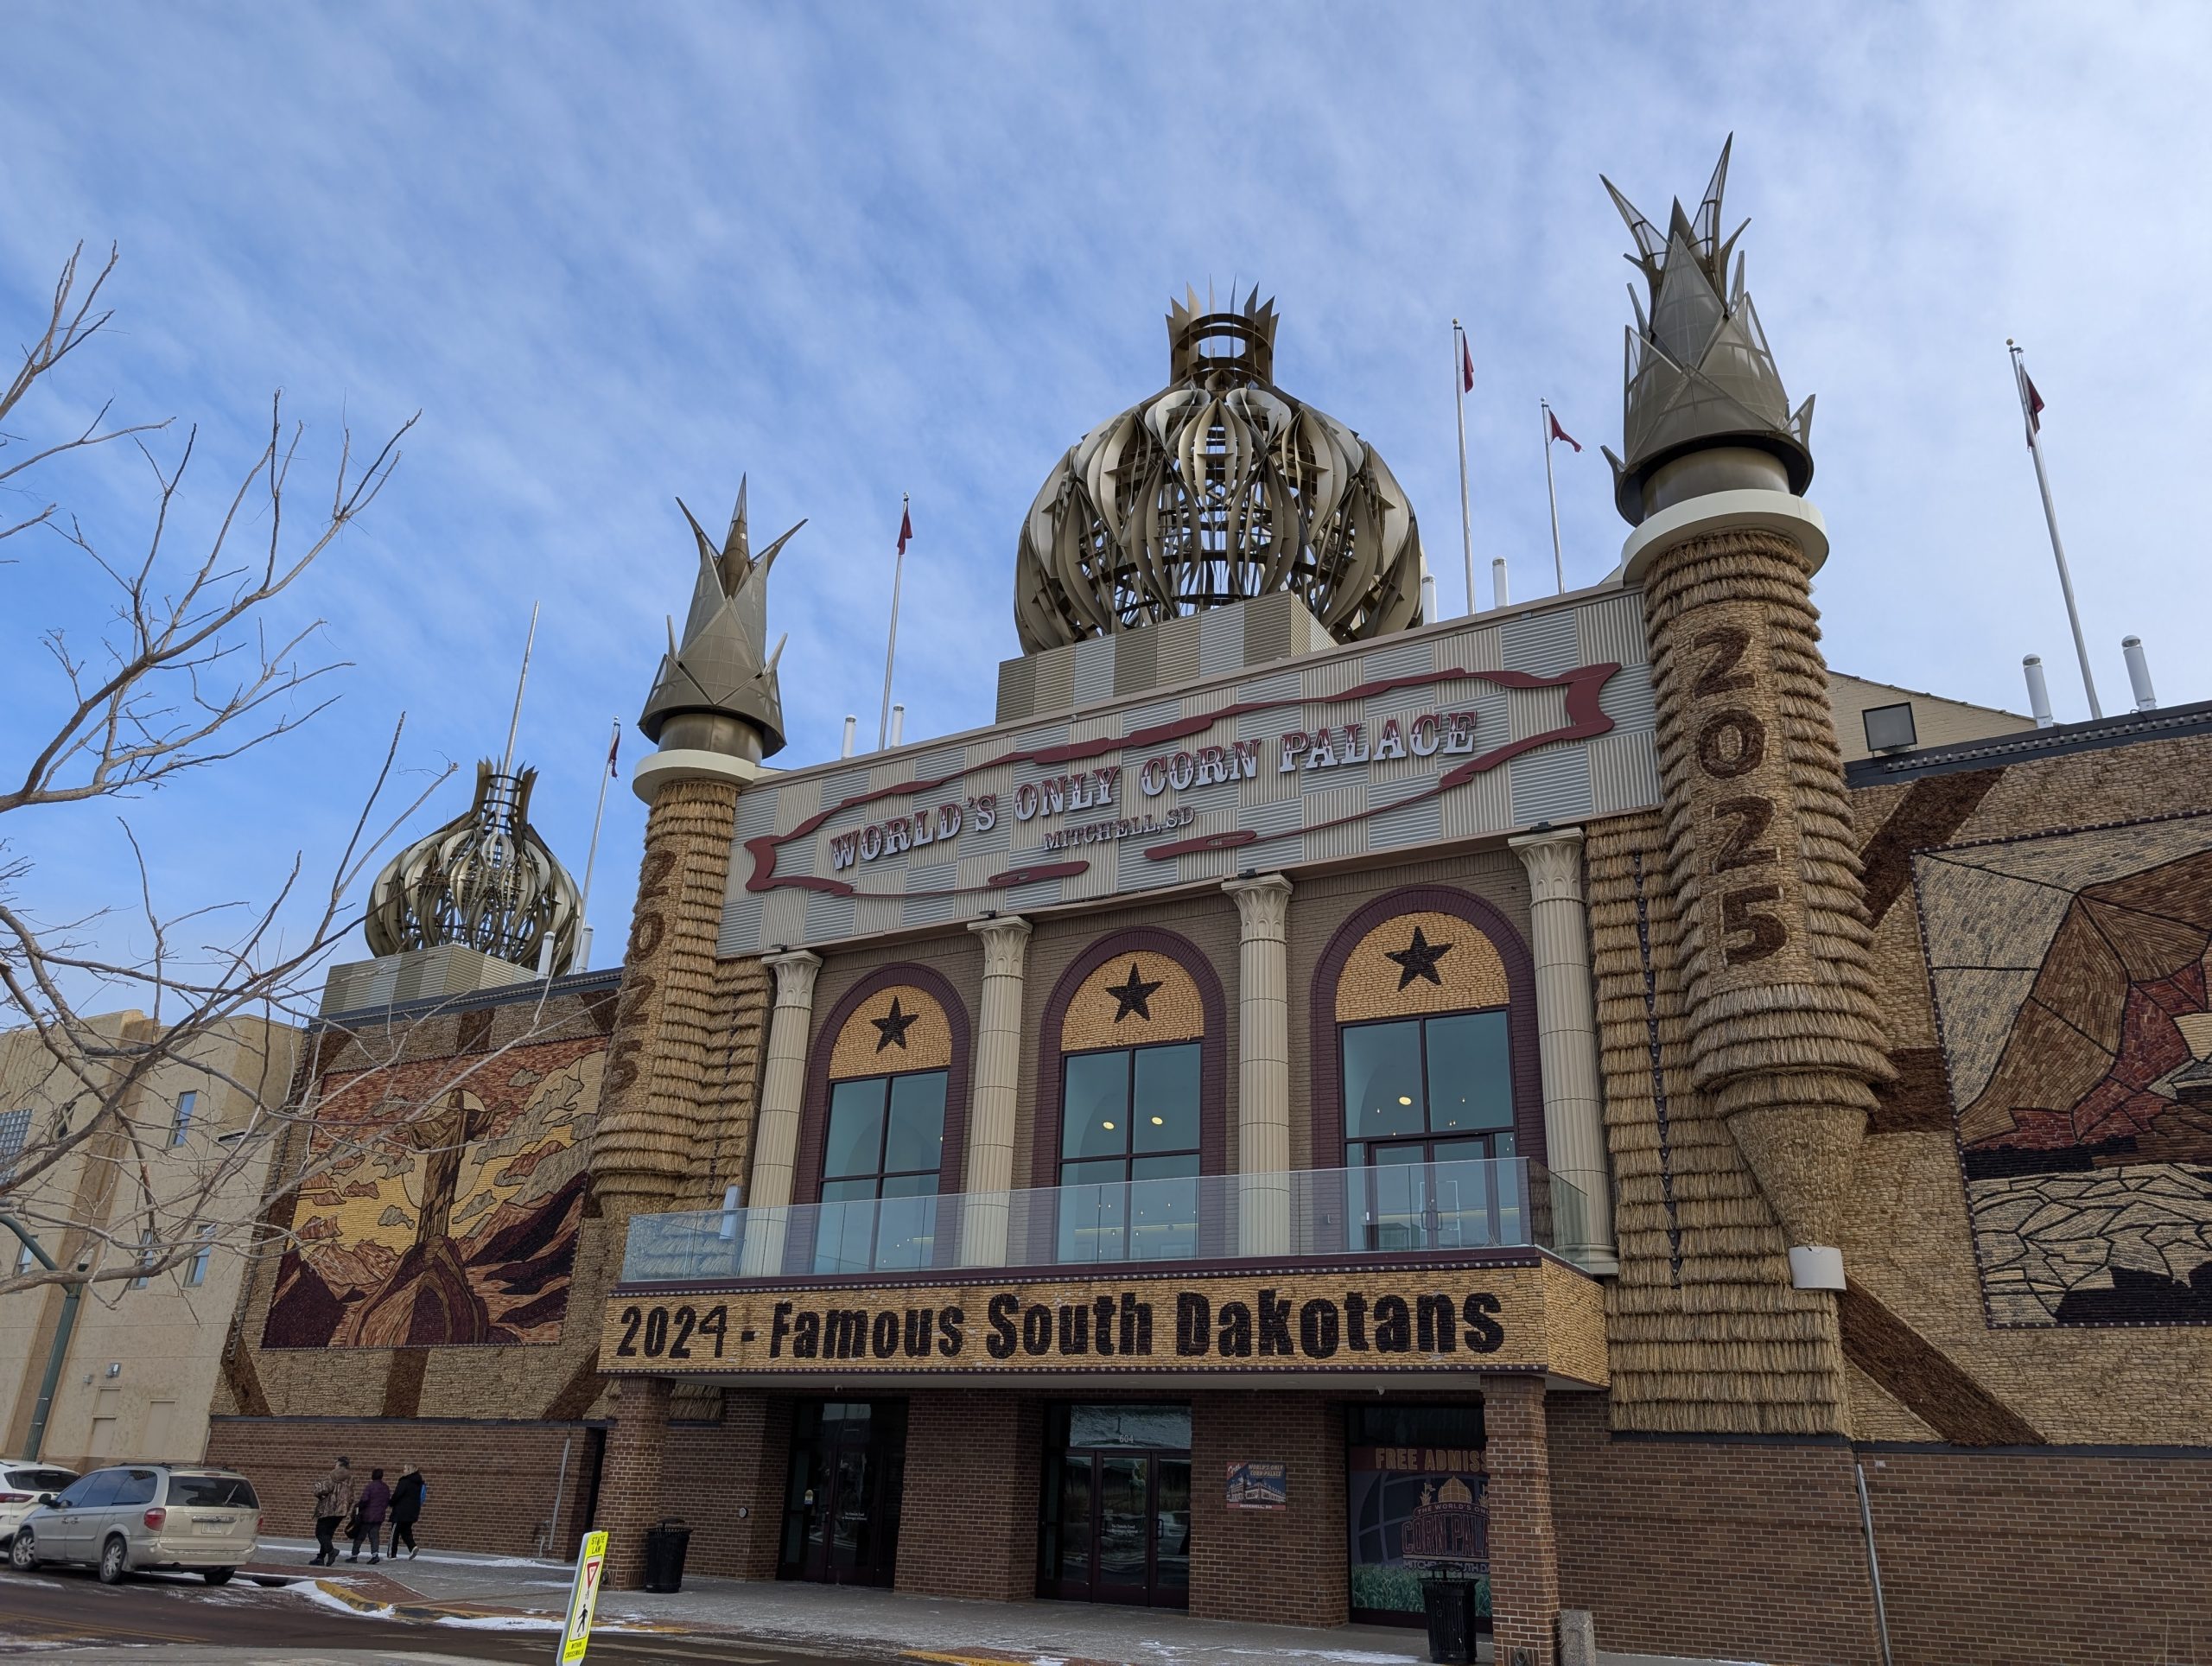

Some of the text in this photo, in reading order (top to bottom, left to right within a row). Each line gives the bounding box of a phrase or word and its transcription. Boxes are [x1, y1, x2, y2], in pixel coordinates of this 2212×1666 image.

[830, 710, 1478, 870] WORLD'S ONLY CORN PALACE
[1691, 625, 1789, 966] 2025
[1043, 805, 1196, 852] MITCHELL, SD
[616, 1304, 728, 1360] 2024
[769, 1301, 965, 1360] Famous
[987, 1292, 1153, 1360] South
[1175, 1288, 1505, 1359] Dakotans
[1118, 1434, 1135, 1444] 604
[1375, 1447, 1487, 1472] FREE ADMISS
[591, 1535, 606, 1545] STATE
[591, 1543, 602, 1554] LAW
[1402, 1513, 1489, 1557] CORN PALA
